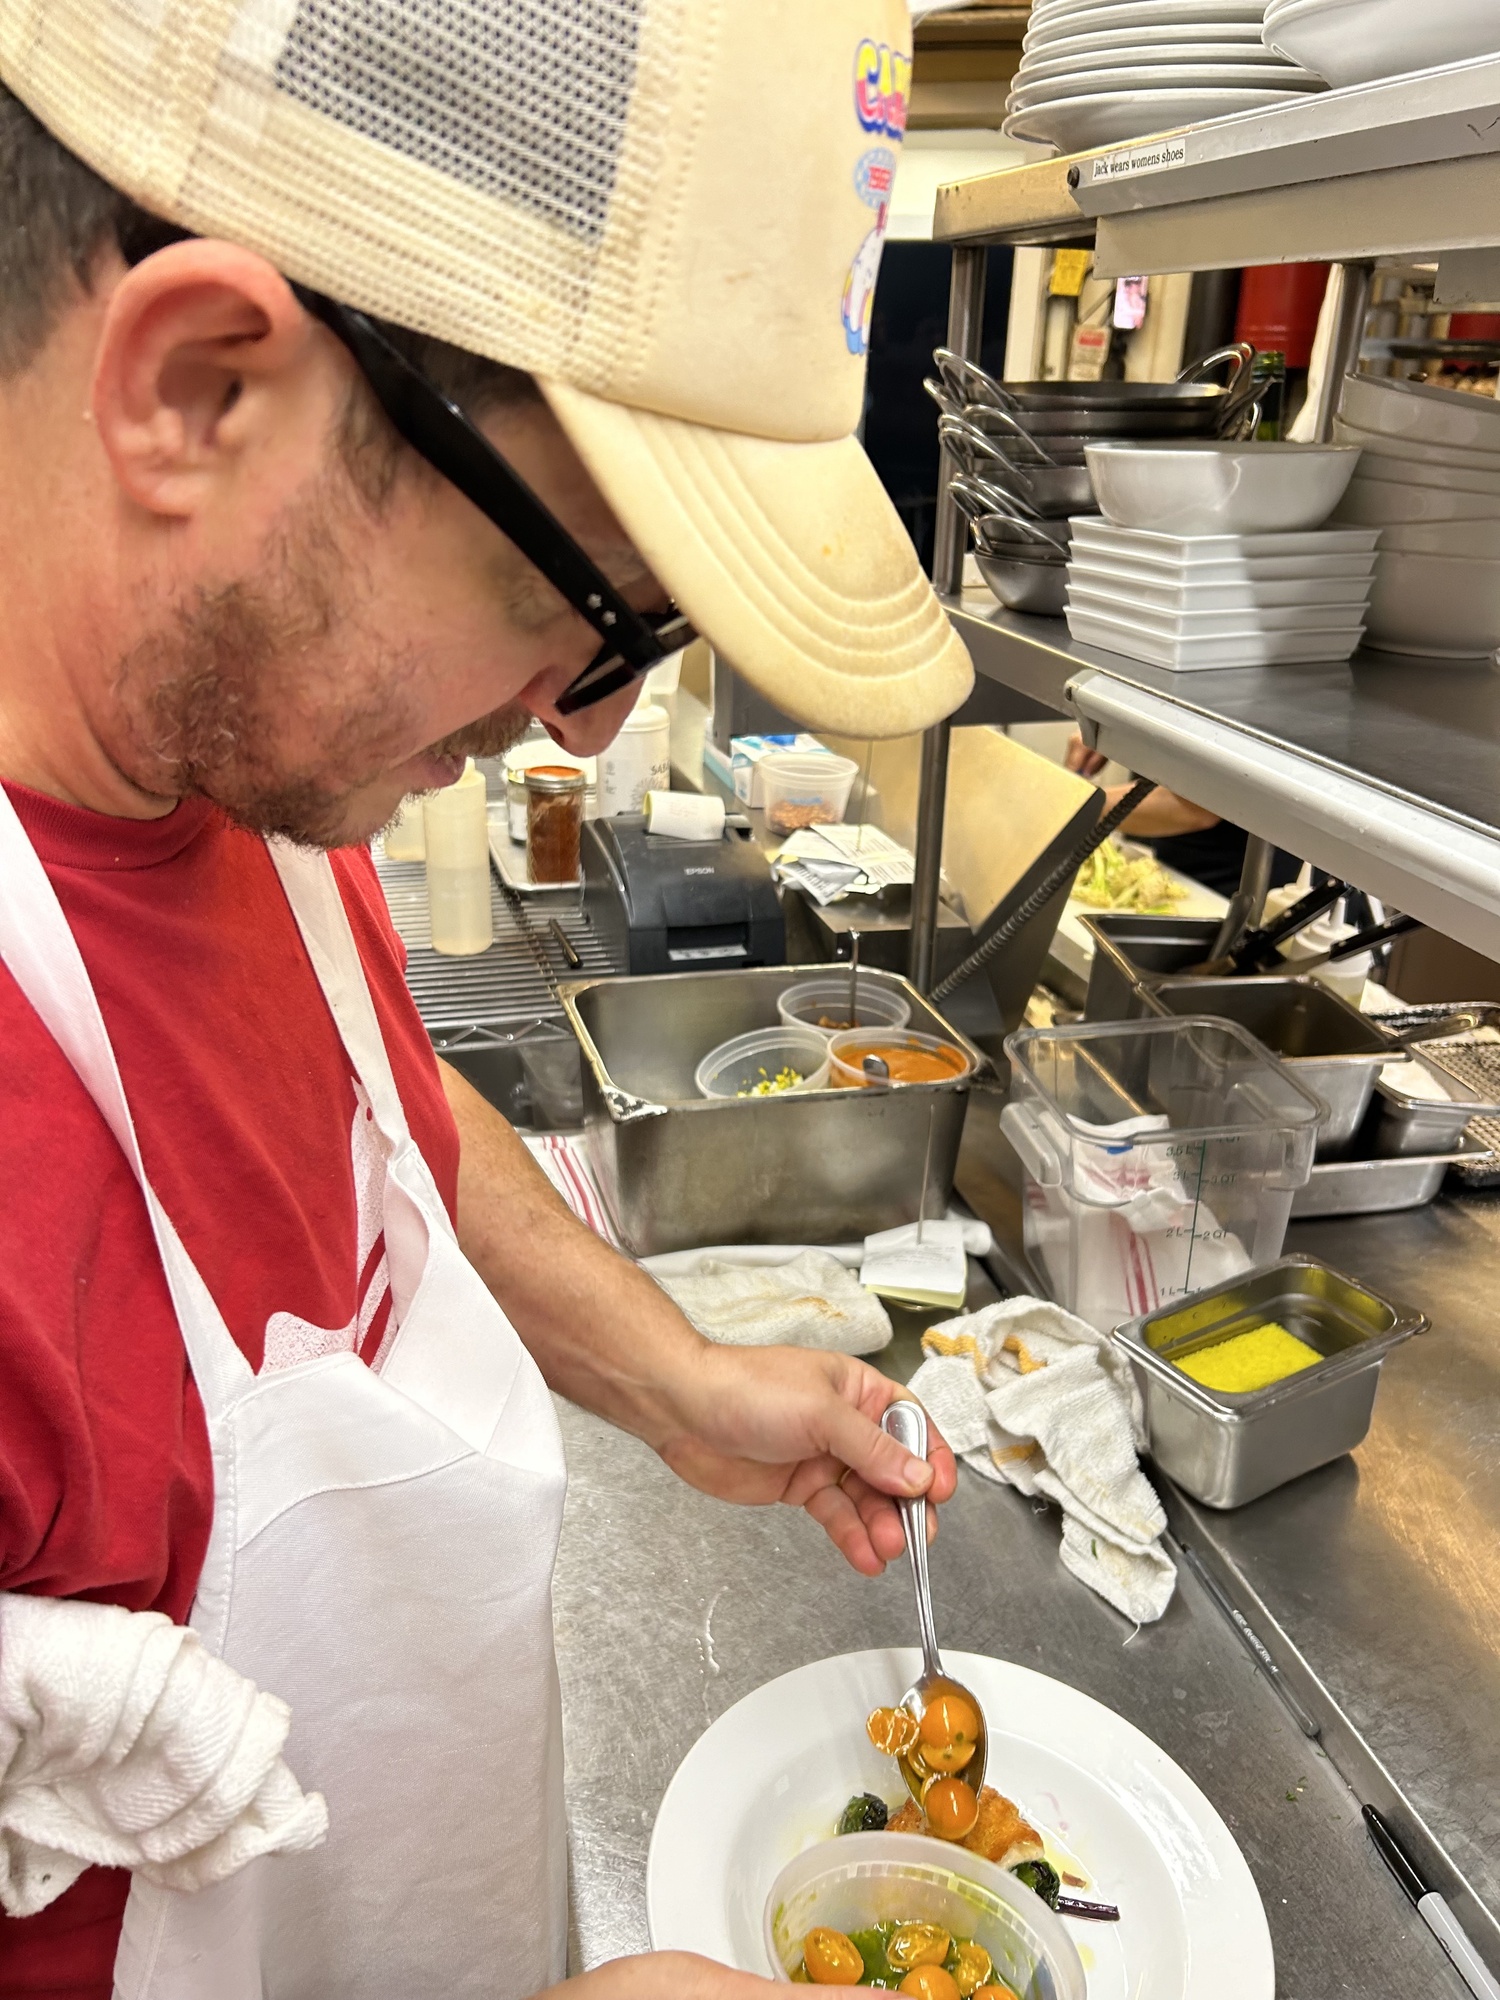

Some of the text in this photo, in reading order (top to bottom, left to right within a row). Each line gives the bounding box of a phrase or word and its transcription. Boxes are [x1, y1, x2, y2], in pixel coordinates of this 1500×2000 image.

[1094, 148, 1184, 177] jack wears womens shoes
